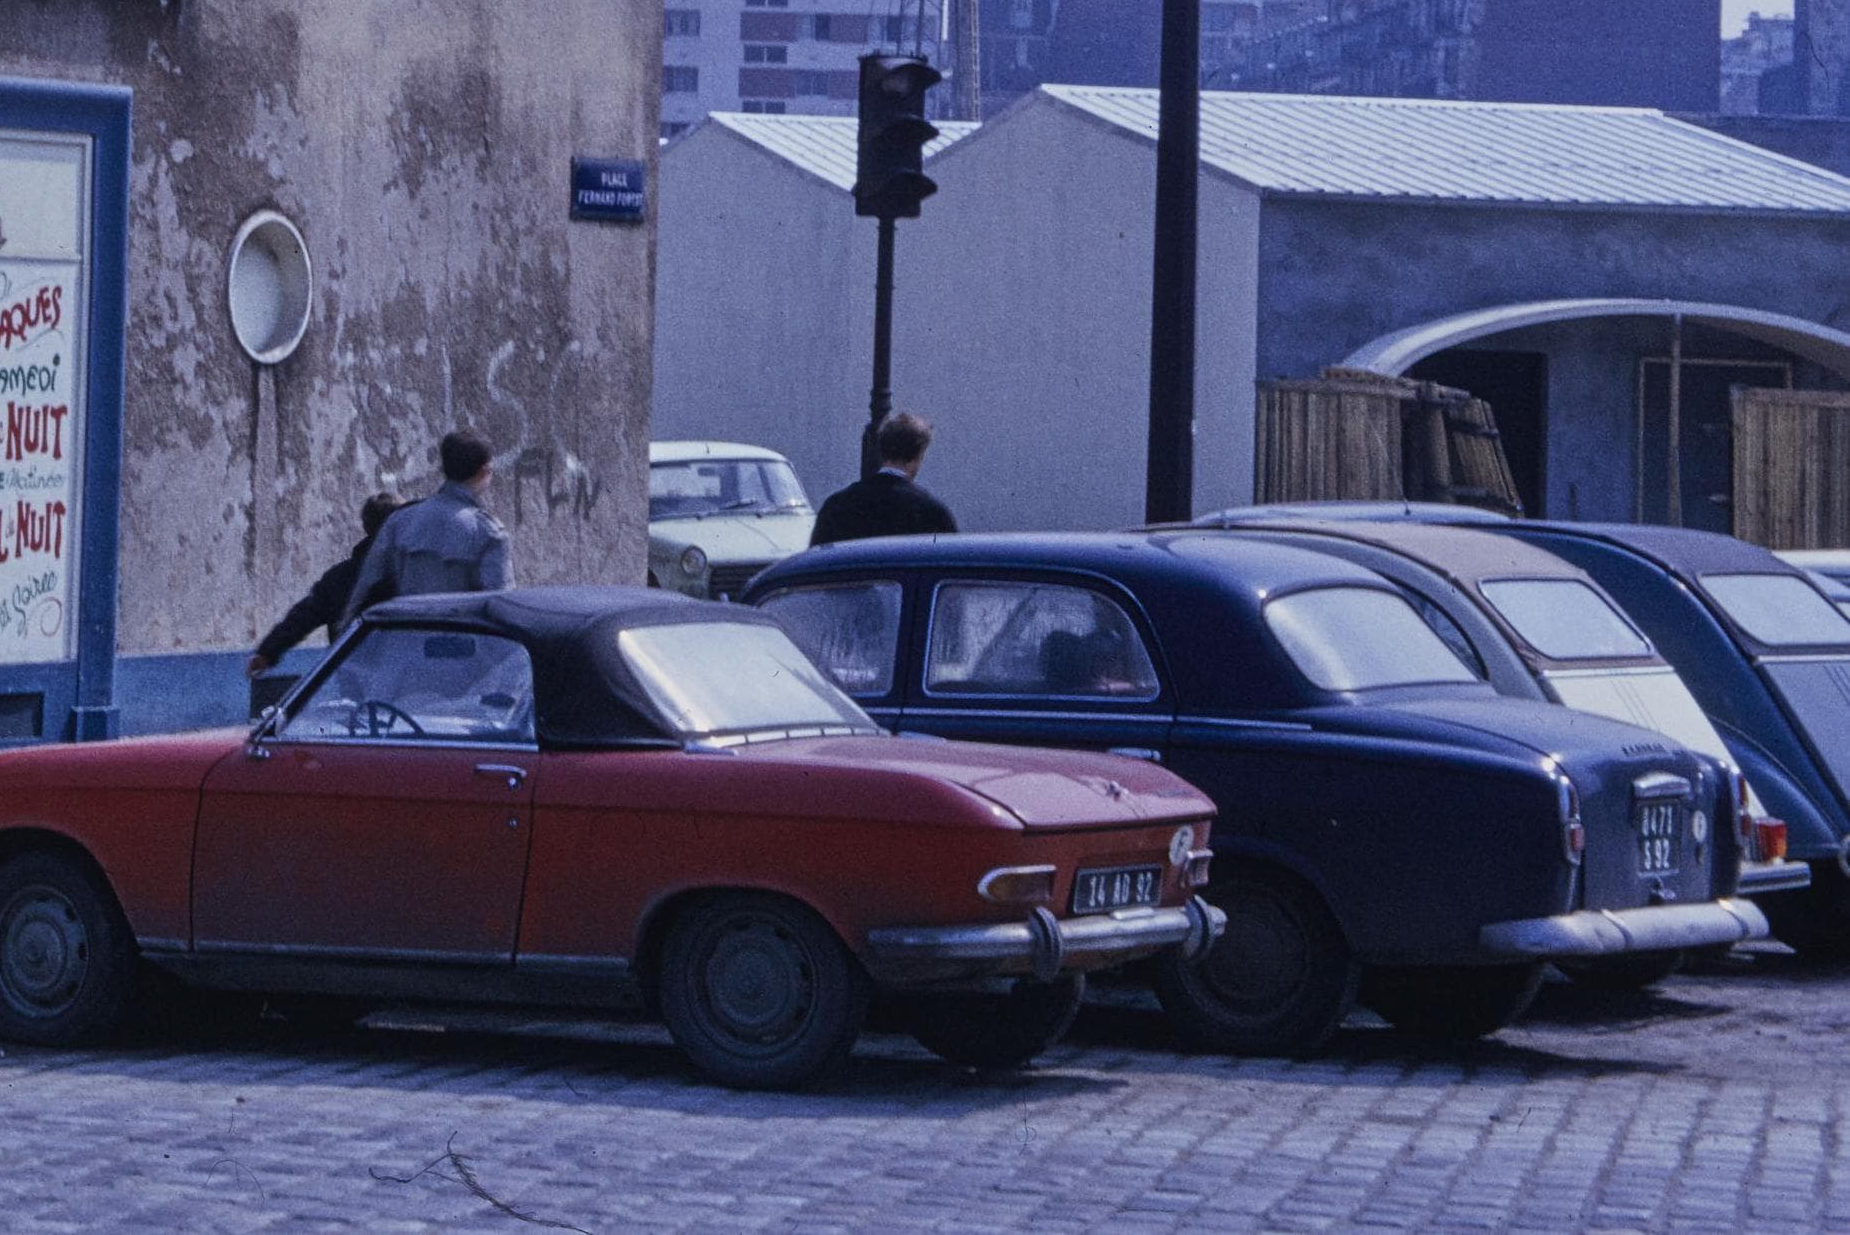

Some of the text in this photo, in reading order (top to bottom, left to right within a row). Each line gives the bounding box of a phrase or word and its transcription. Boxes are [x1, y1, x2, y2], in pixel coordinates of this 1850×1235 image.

[600, 170, 629, 187] PLACE
[6, 400, 68, 462] NUIT
[15, 498, 67, 560] NUIT
